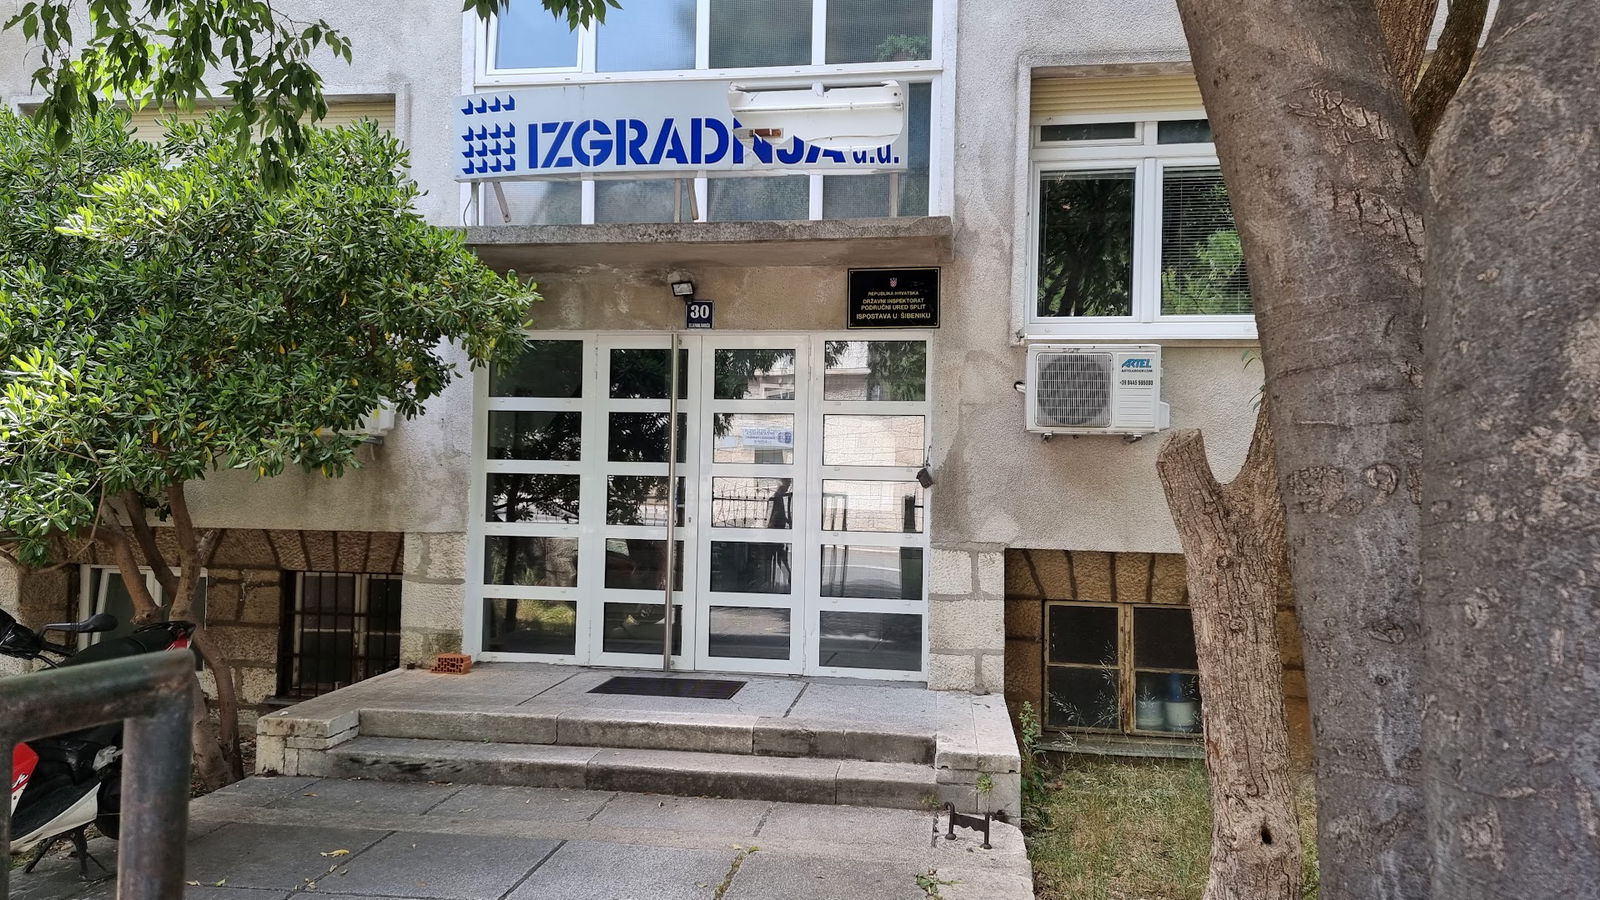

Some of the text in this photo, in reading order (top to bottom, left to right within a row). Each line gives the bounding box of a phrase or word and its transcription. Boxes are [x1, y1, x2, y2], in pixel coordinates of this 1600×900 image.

[690, 304, 710, 319] 30
[900, 311, 931, 319] ŠIBENIKU
[1121, 358, 1152, 368] ARTEL
